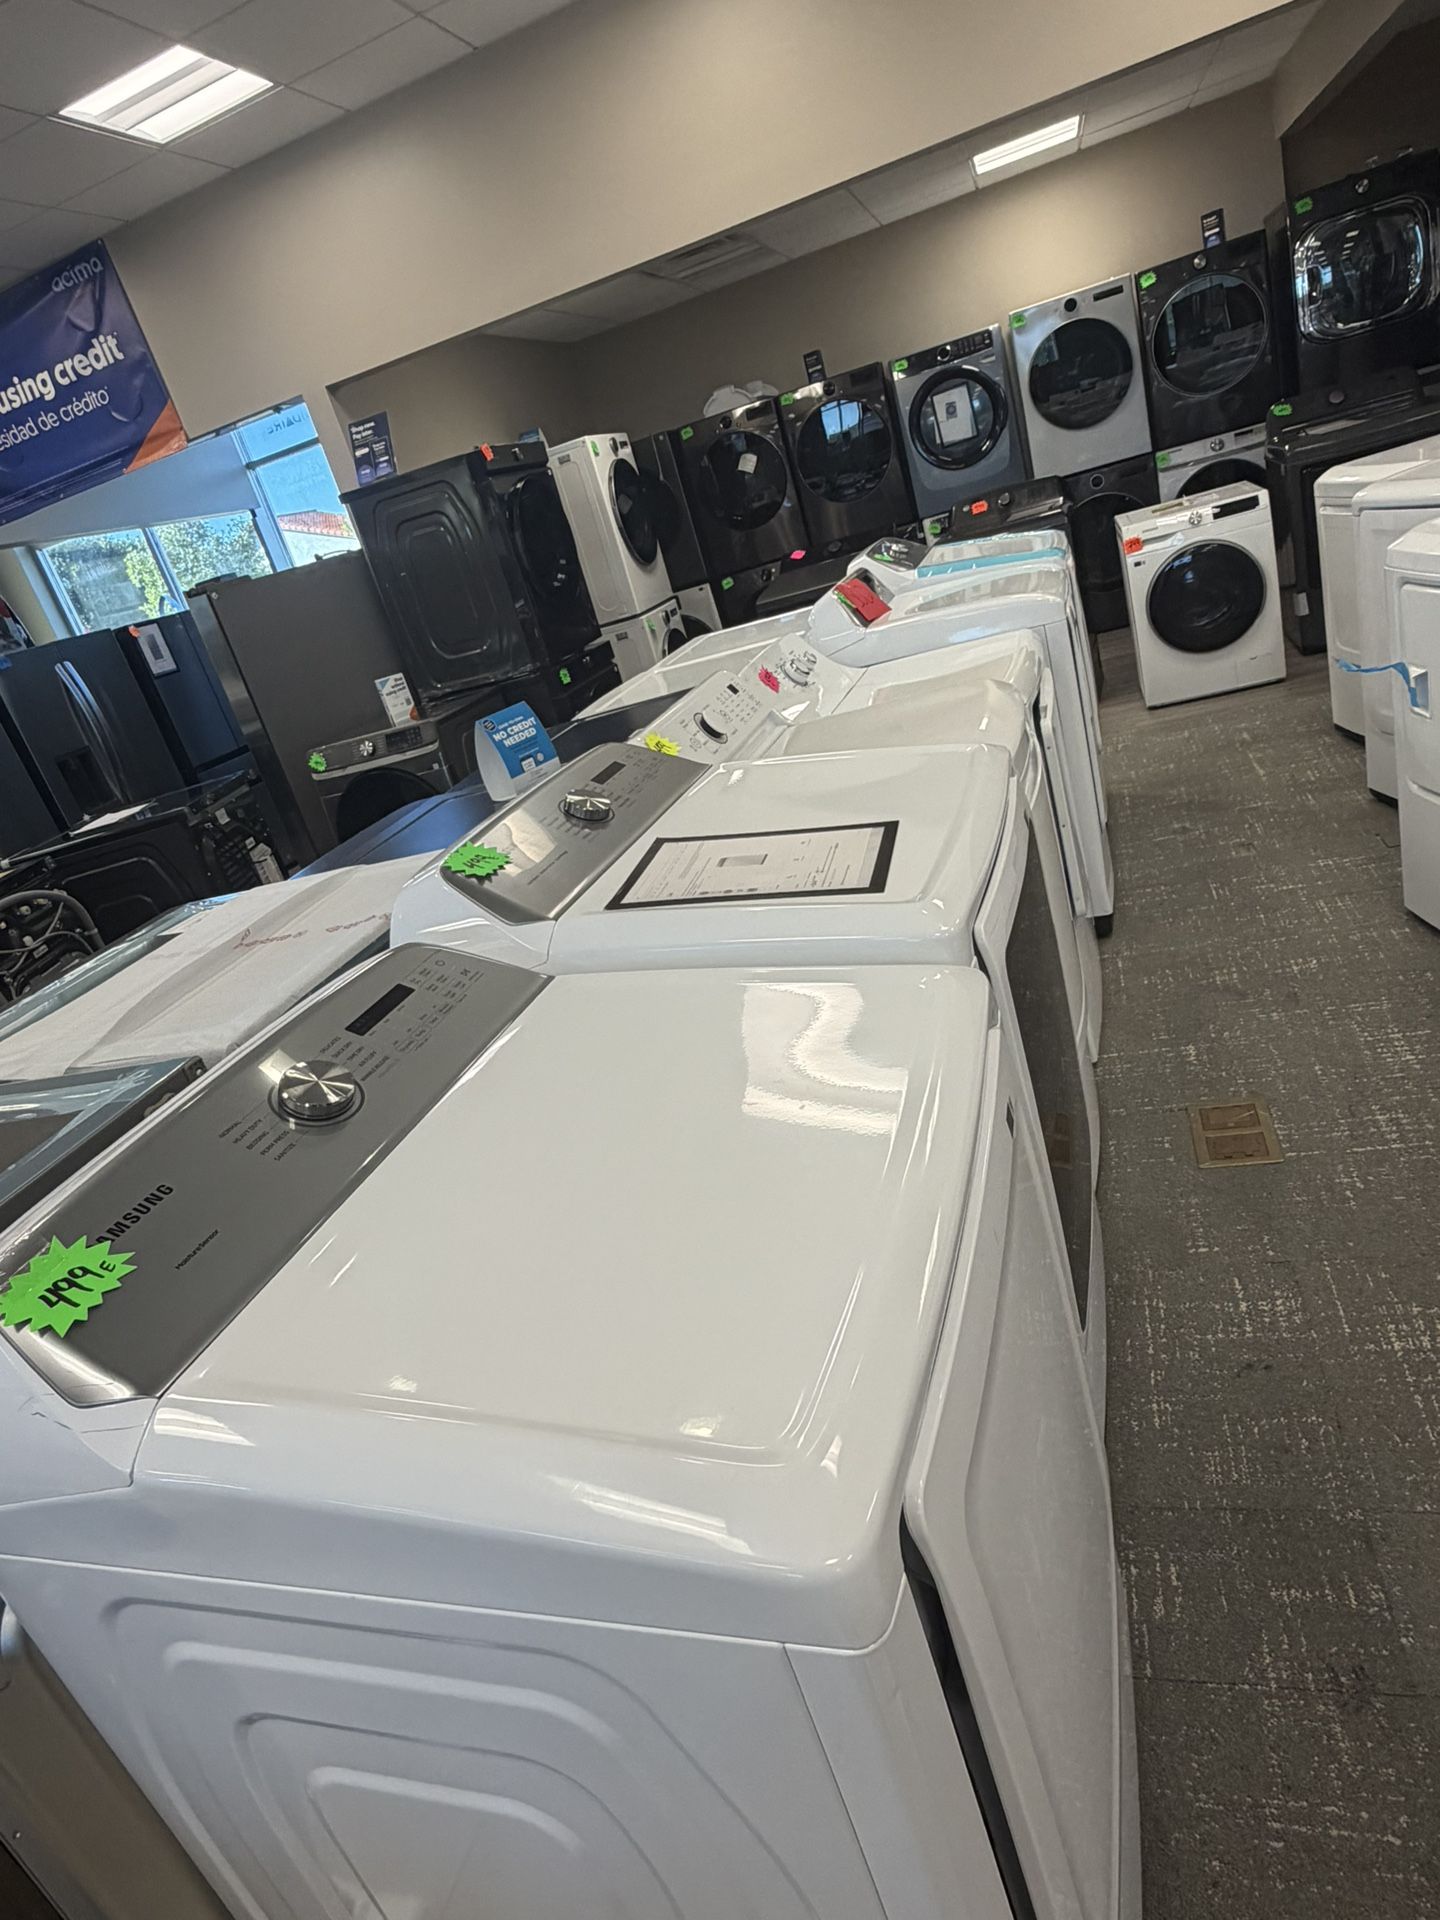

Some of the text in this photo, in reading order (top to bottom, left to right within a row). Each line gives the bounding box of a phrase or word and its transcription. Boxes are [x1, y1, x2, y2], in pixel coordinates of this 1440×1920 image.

[52, 257, 104, 292] acima
[0, 333, 124, 414] using credit
[37, 411, 60, 431] de
[60, 388, 110, 422] crédito
[492, 730, 508, 742] NO
[507, 716, 537, 735] CREDIT
[502, 727, 537, 748] NEEDED
[95, 1184, 174, 1244] AMSUNG
[37, 1259, 117, 1309] 499 E
